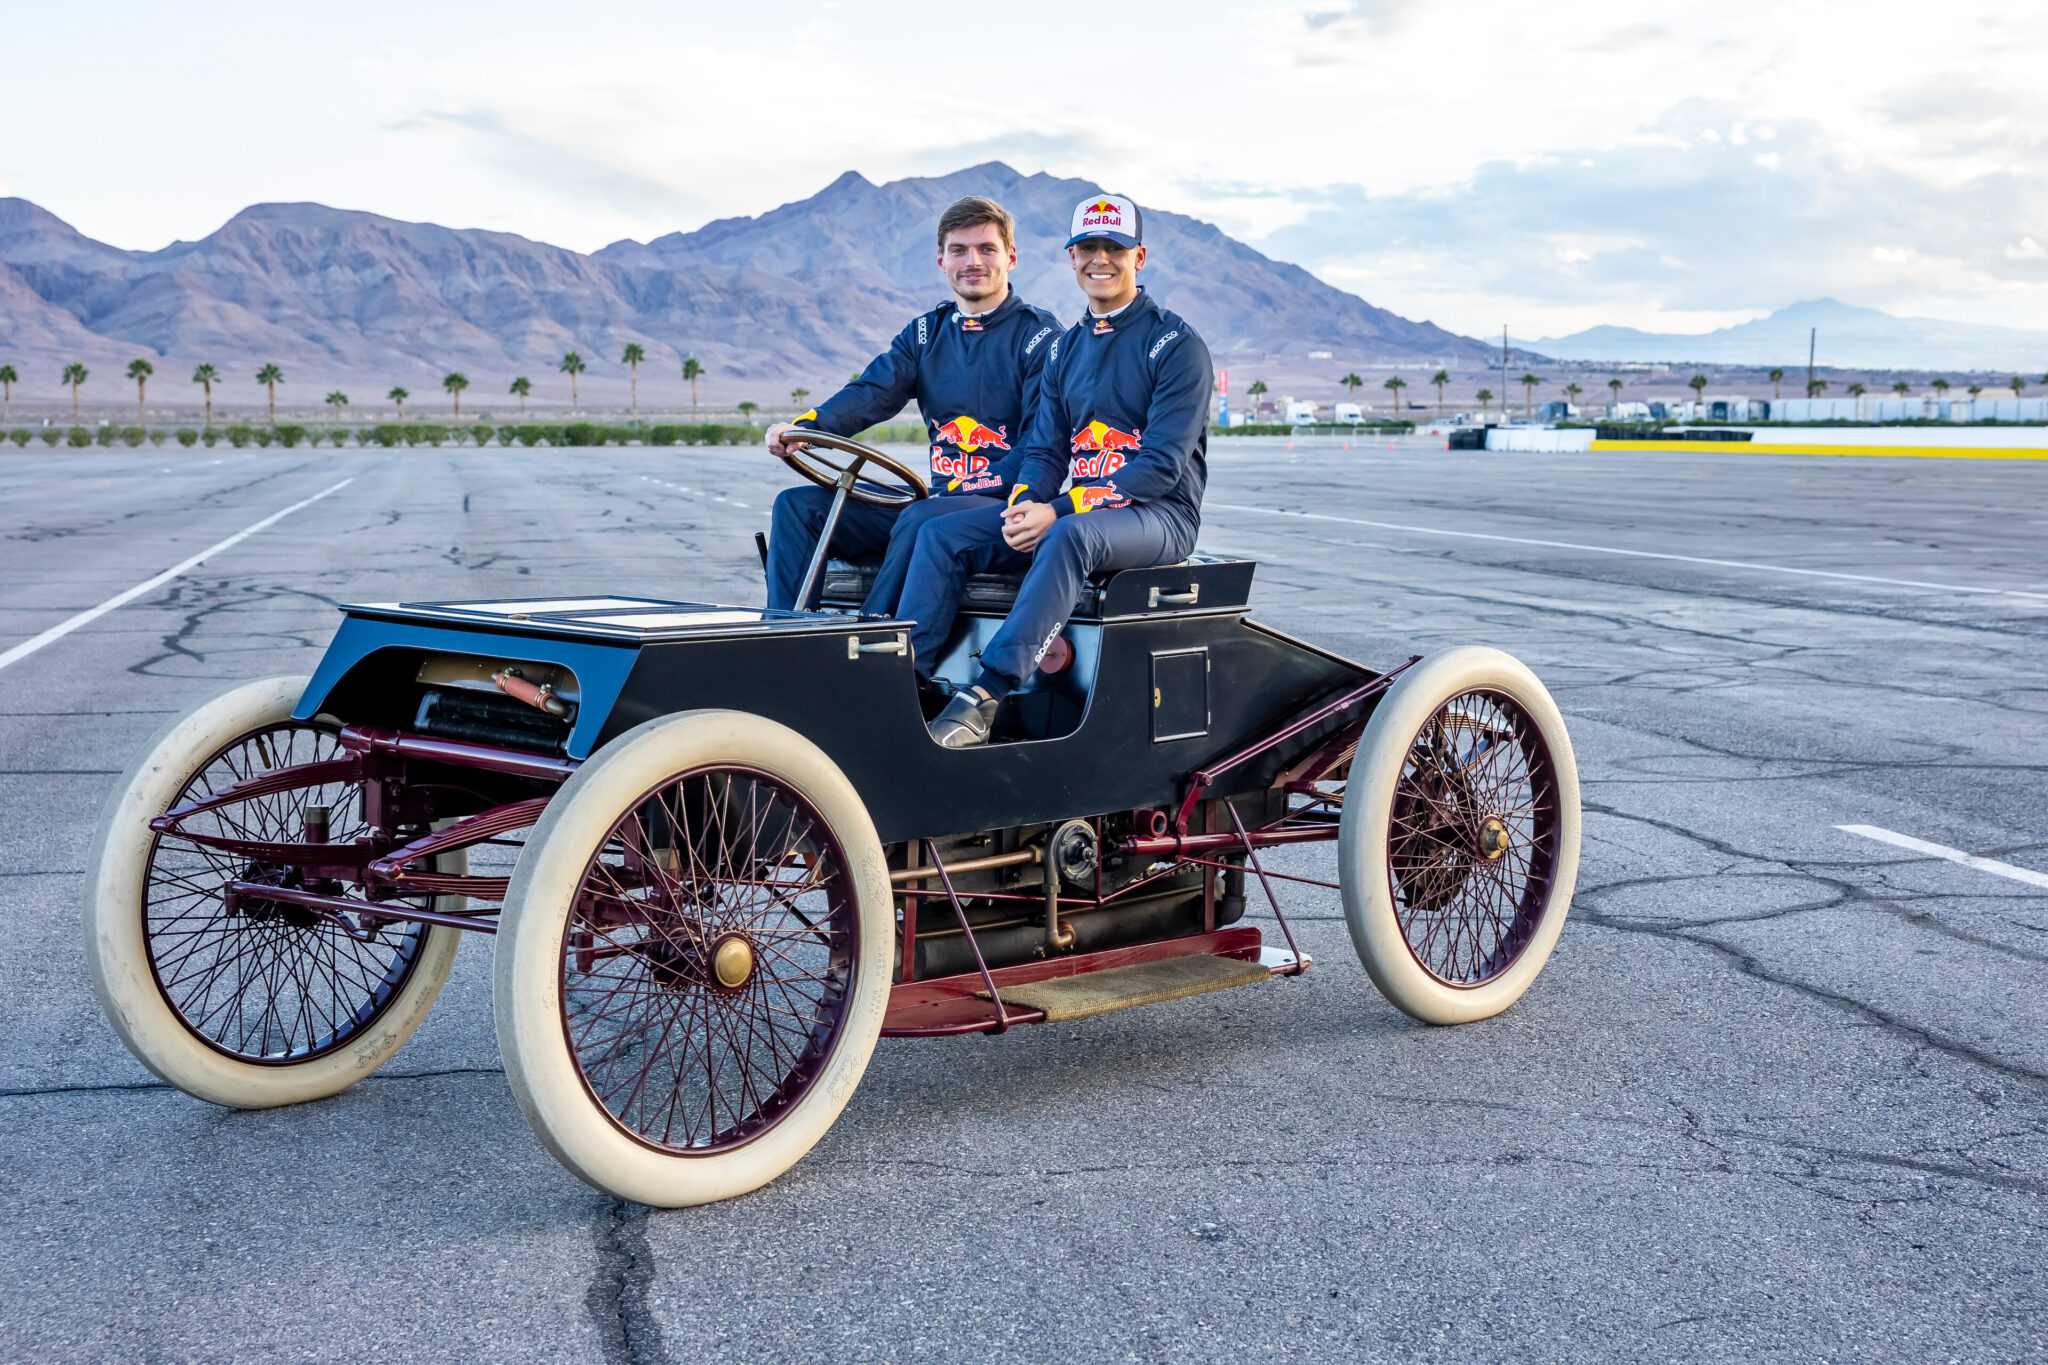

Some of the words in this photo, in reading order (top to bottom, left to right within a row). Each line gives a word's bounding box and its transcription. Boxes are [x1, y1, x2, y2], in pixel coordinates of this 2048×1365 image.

[1082, 215, 1101, 227] Red
[1102, 215, 1121, 226] Bull
[918, 316, 927, 344] sparco
[1025, 327, 1052, 354] sparco
[1149, 330, 1179, 359] sparco
[932, 446, 968, 478] Red
[962, 479, 982, 492] Red
[982, 475, 1003, 488] Bull
[1034, 622, 1062, 664] sparco
